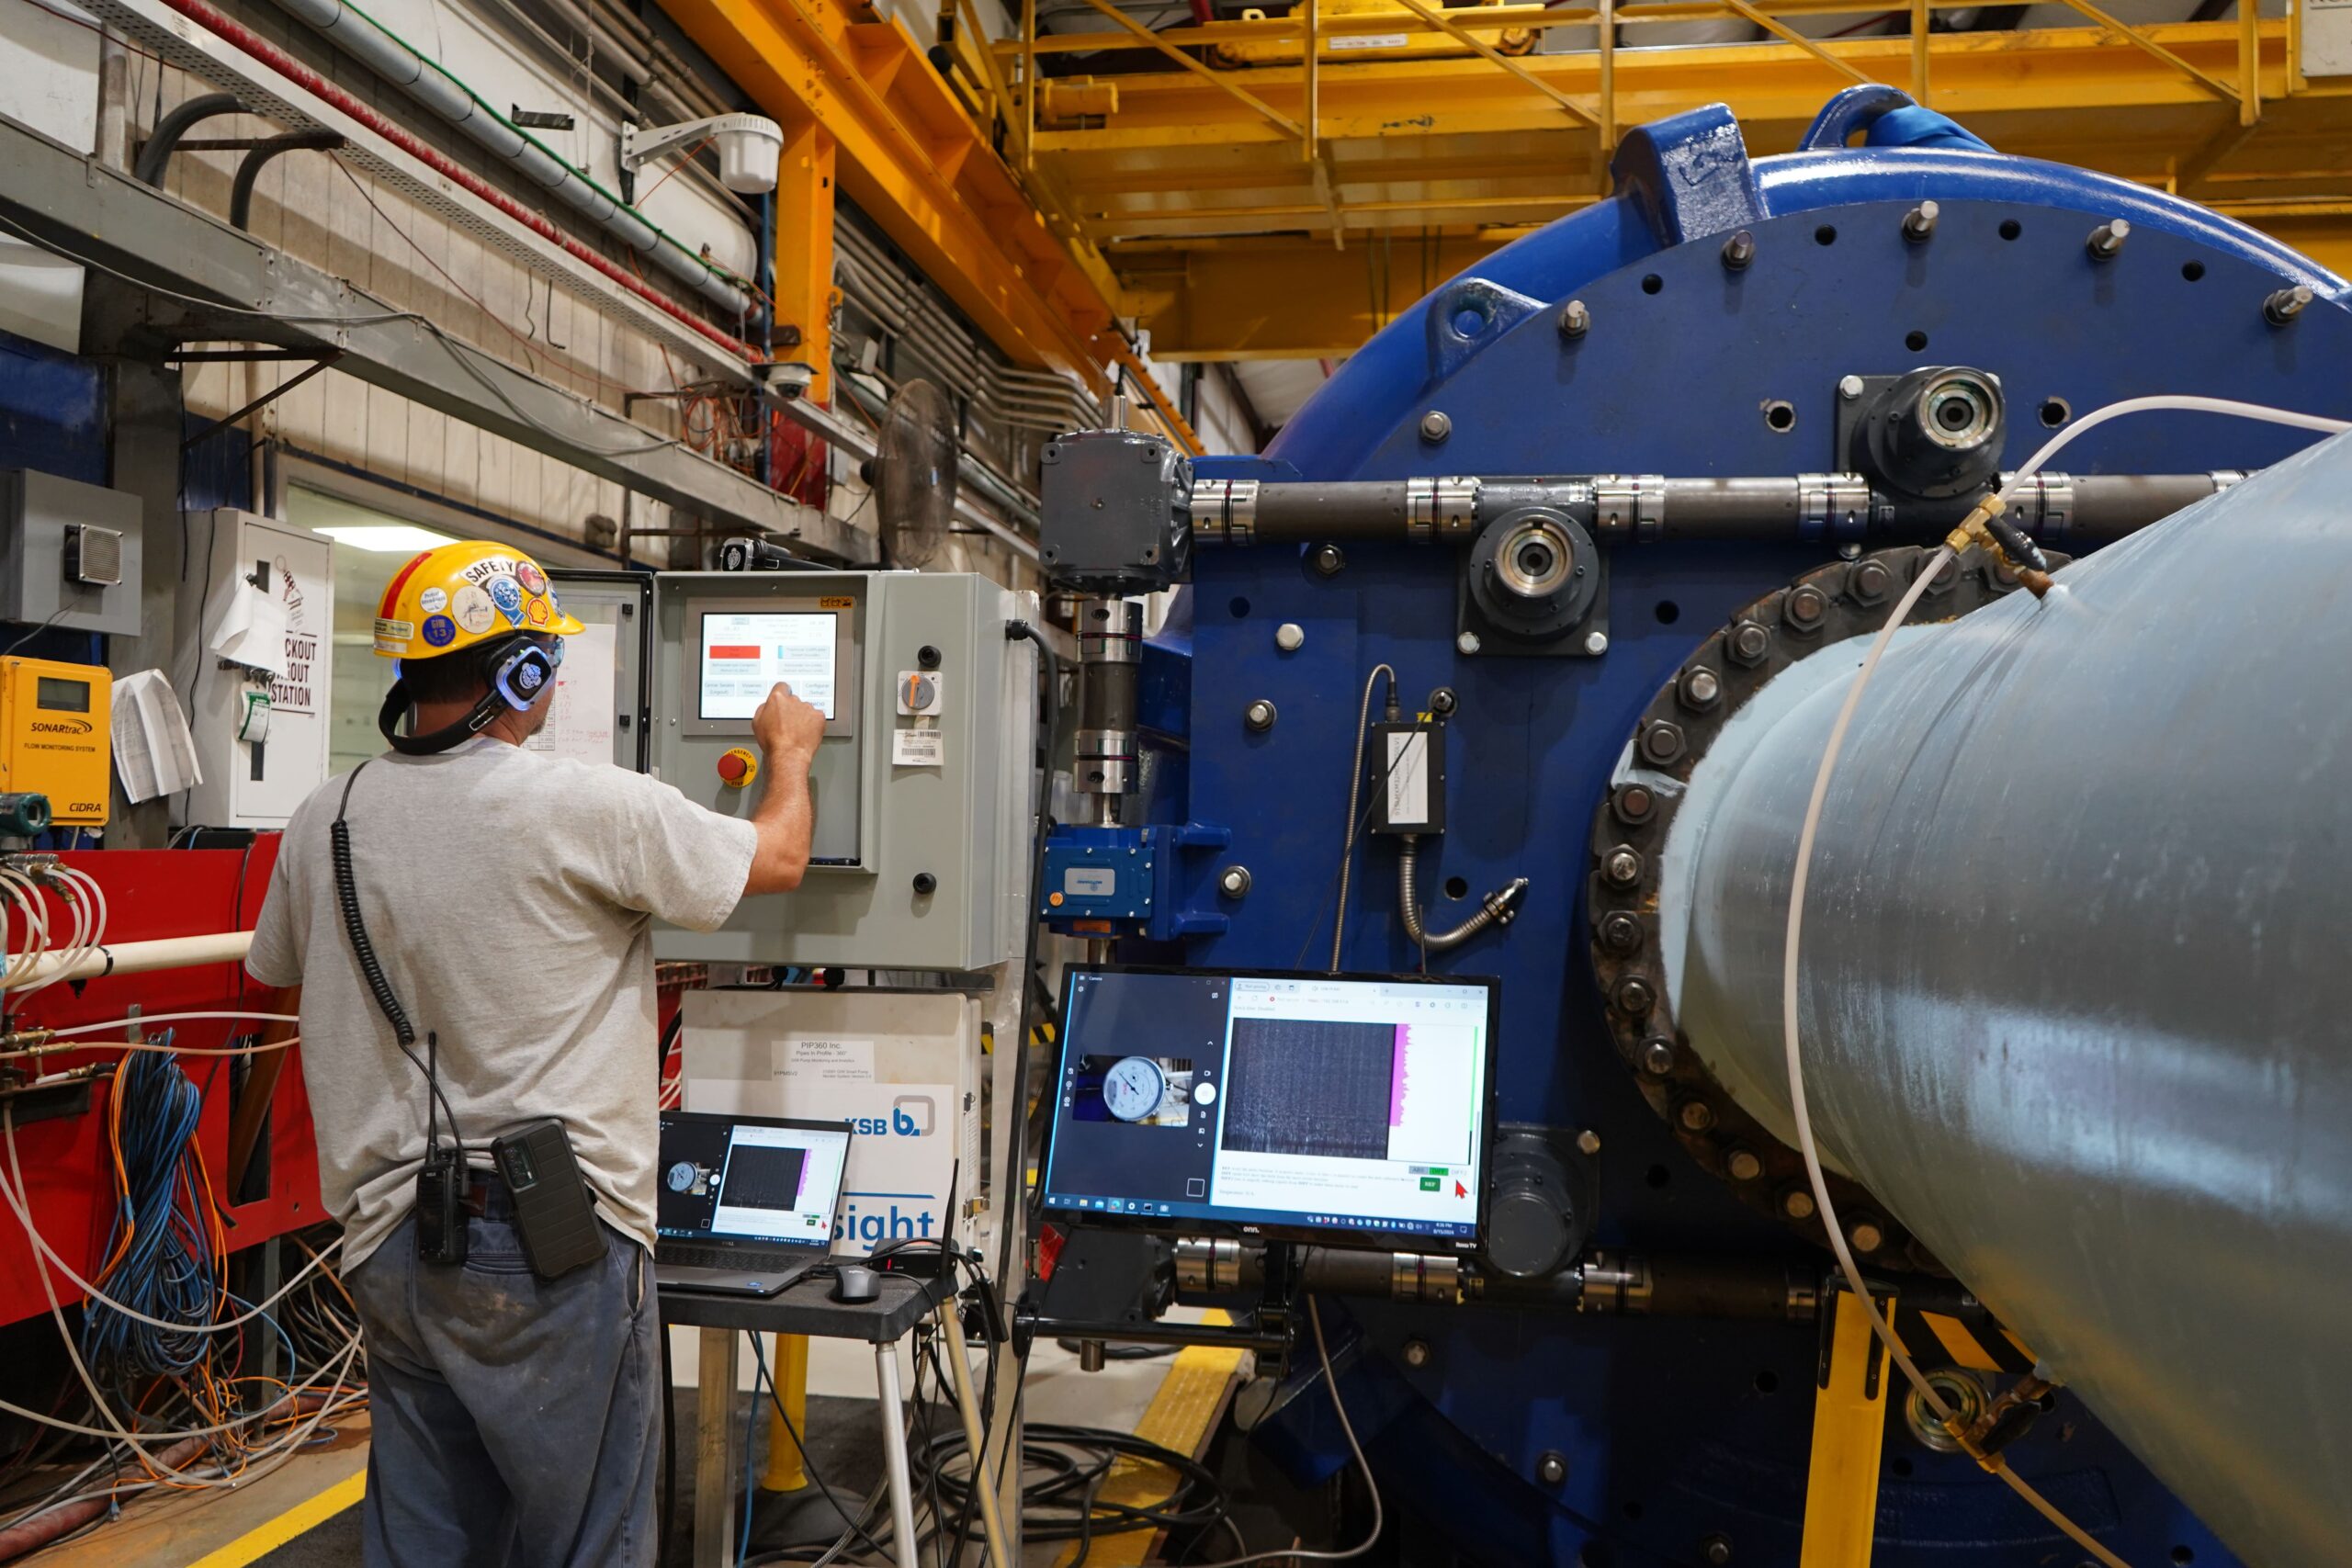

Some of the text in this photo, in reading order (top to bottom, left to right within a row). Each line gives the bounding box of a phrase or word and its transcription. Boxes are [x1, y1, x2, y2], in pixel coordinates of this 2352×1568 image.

[466, 560, 514, 582] SAFETY
[433, 629, 447, 637] 13
[285, 638, 316, 660] CKOUT
[271, 683, 311, 706] STATION
[31, 722, 83, 735] SONARtrac
[41, 743, 74, 751] MONITORING
[845, 1118, 888, 1135] KSB
